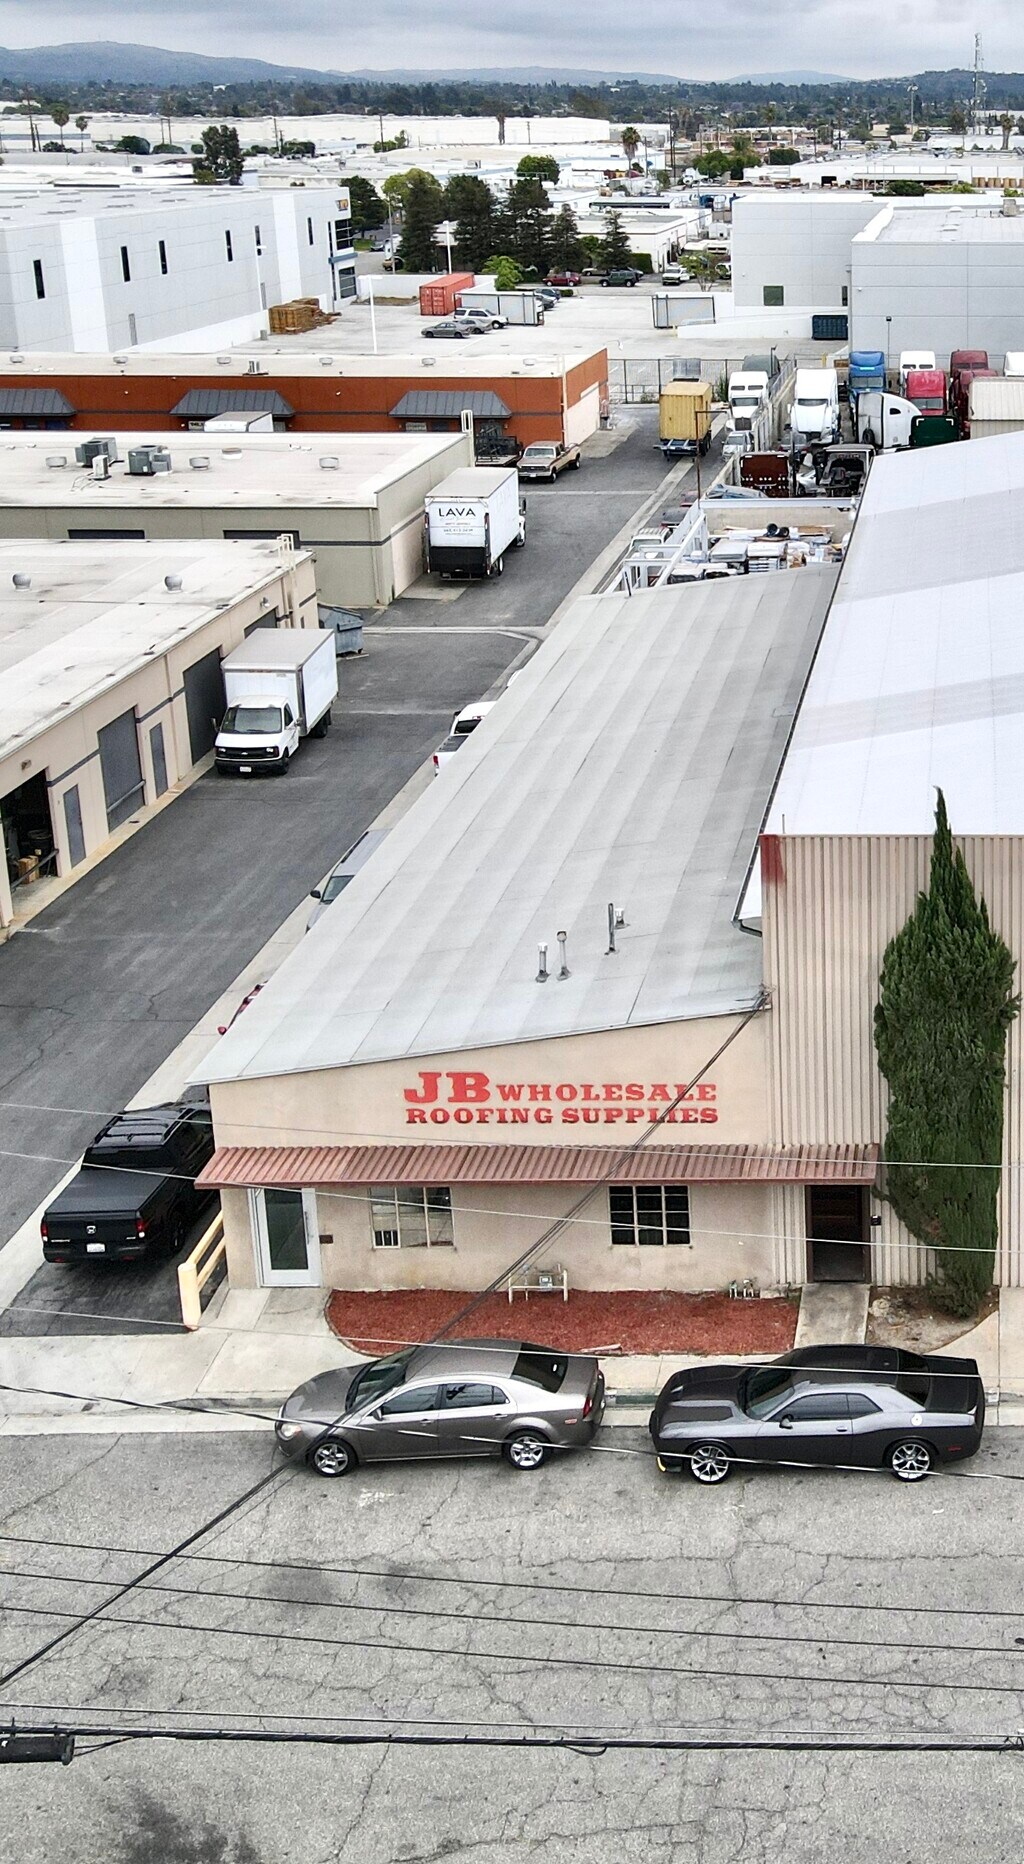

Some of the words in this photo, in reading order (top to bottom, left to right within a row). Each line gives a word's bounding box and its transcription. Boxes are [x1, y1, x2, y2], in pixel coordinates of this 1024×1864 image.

[438, 507, 476, 517] LAVA
[403, 1071, 491, 1104] JB
[496, 1083, 717, 1102] WHOLESALE
[405, 1107, 554, 1124] ROOFING
[561, 1107, 719, 1124] SUPPLIES
